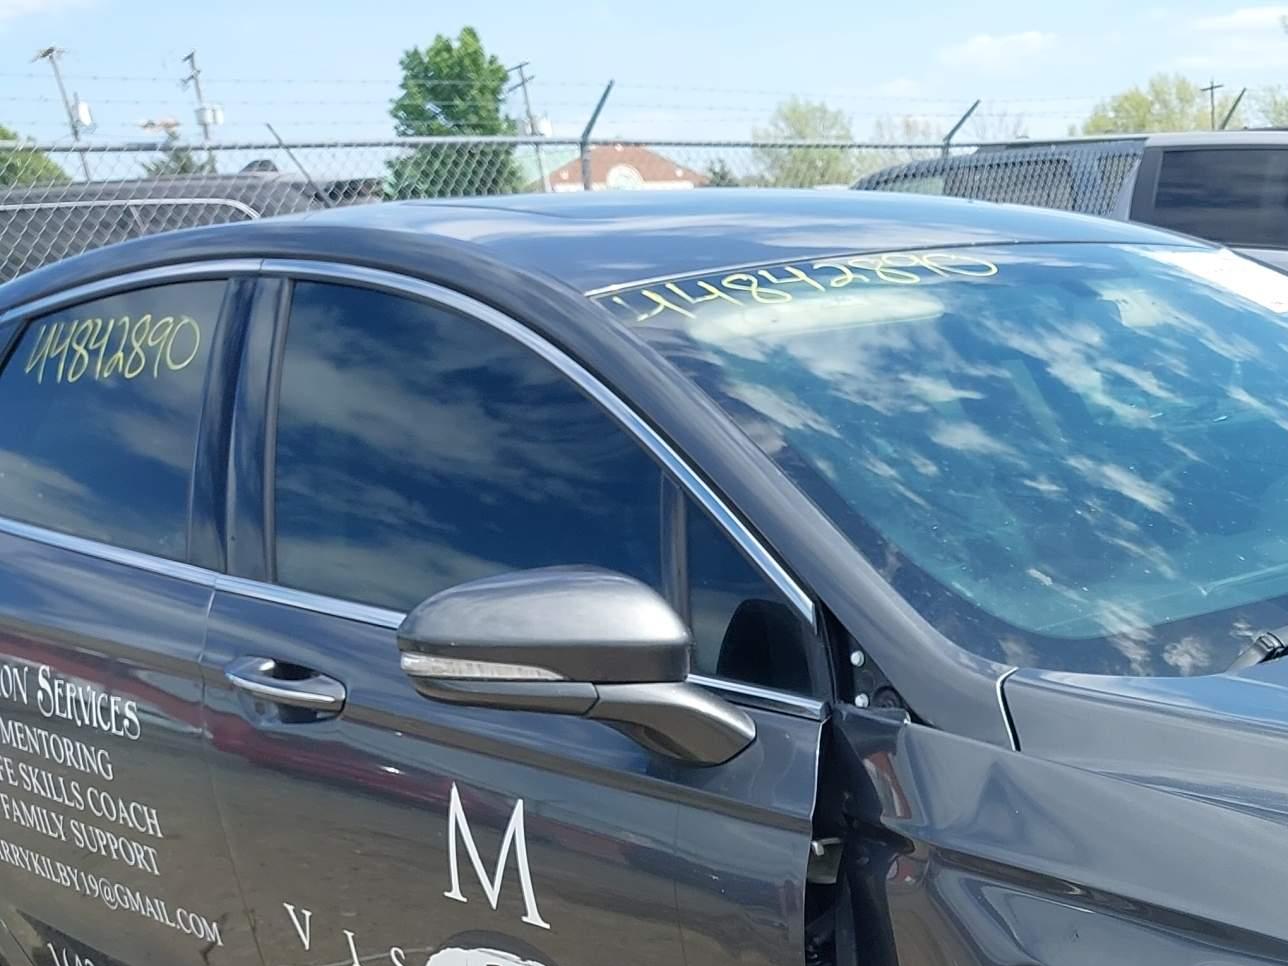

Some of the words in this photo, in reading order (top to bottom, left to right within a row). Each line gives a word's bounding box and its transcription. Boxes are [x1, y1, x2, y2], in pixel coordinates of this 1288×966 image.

[25, 314, 200, 384] 44842890
[0, 664, 28, 704] ON
[0, 716, 114, 780] MENTORING
[0, 793, 67, 842] FAMILY
[70, 819, 160, 875] SUPPORT
[18, 762, 84, 811] SKILLS
[87, 786, 163, 838] COACH
